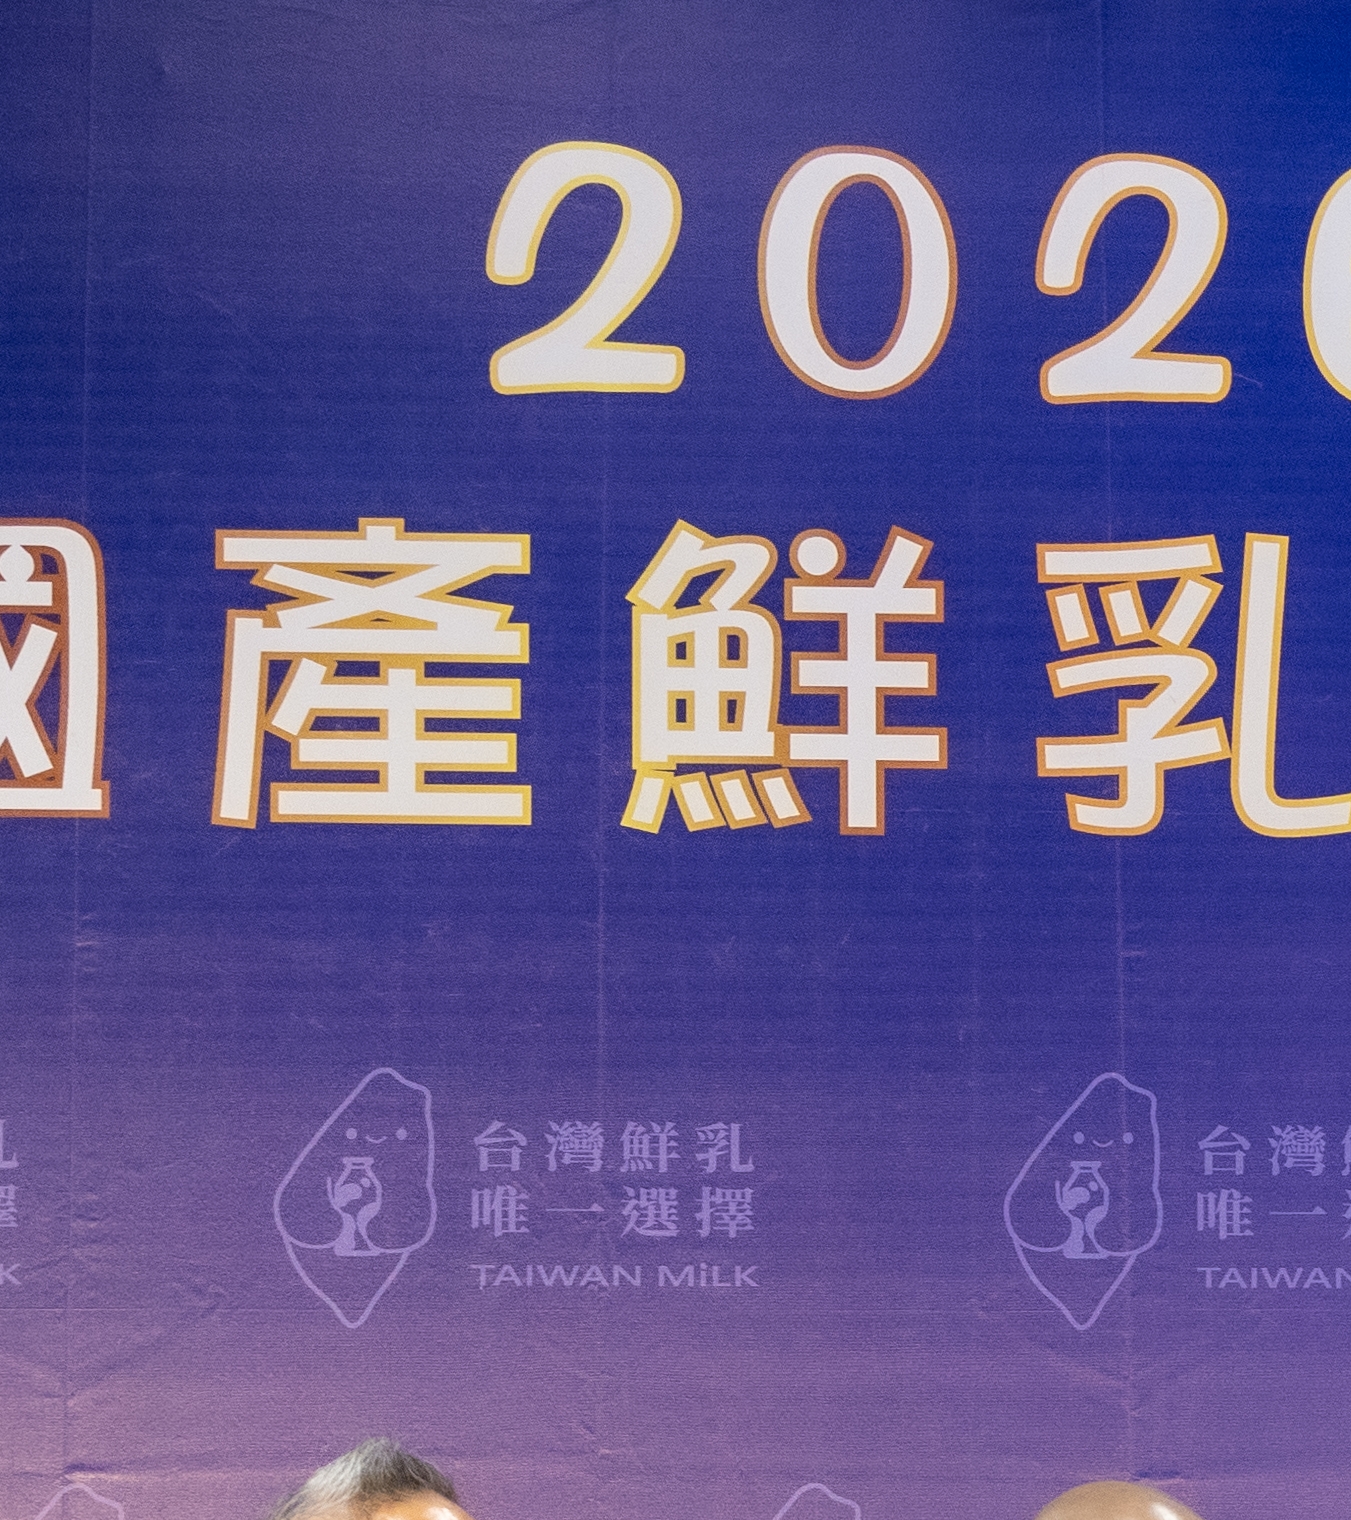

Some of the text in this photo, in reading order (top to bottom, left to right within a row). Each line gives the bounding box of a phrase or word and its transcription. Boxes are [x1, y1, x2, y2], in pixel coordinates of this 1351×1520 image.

[472, 1119, 756, 1173] 台灣鮮乳
[470, 1185, 755, 1238] 唯一選擇
[470, 1262, 759, 1288] TAIWAN MiLK
